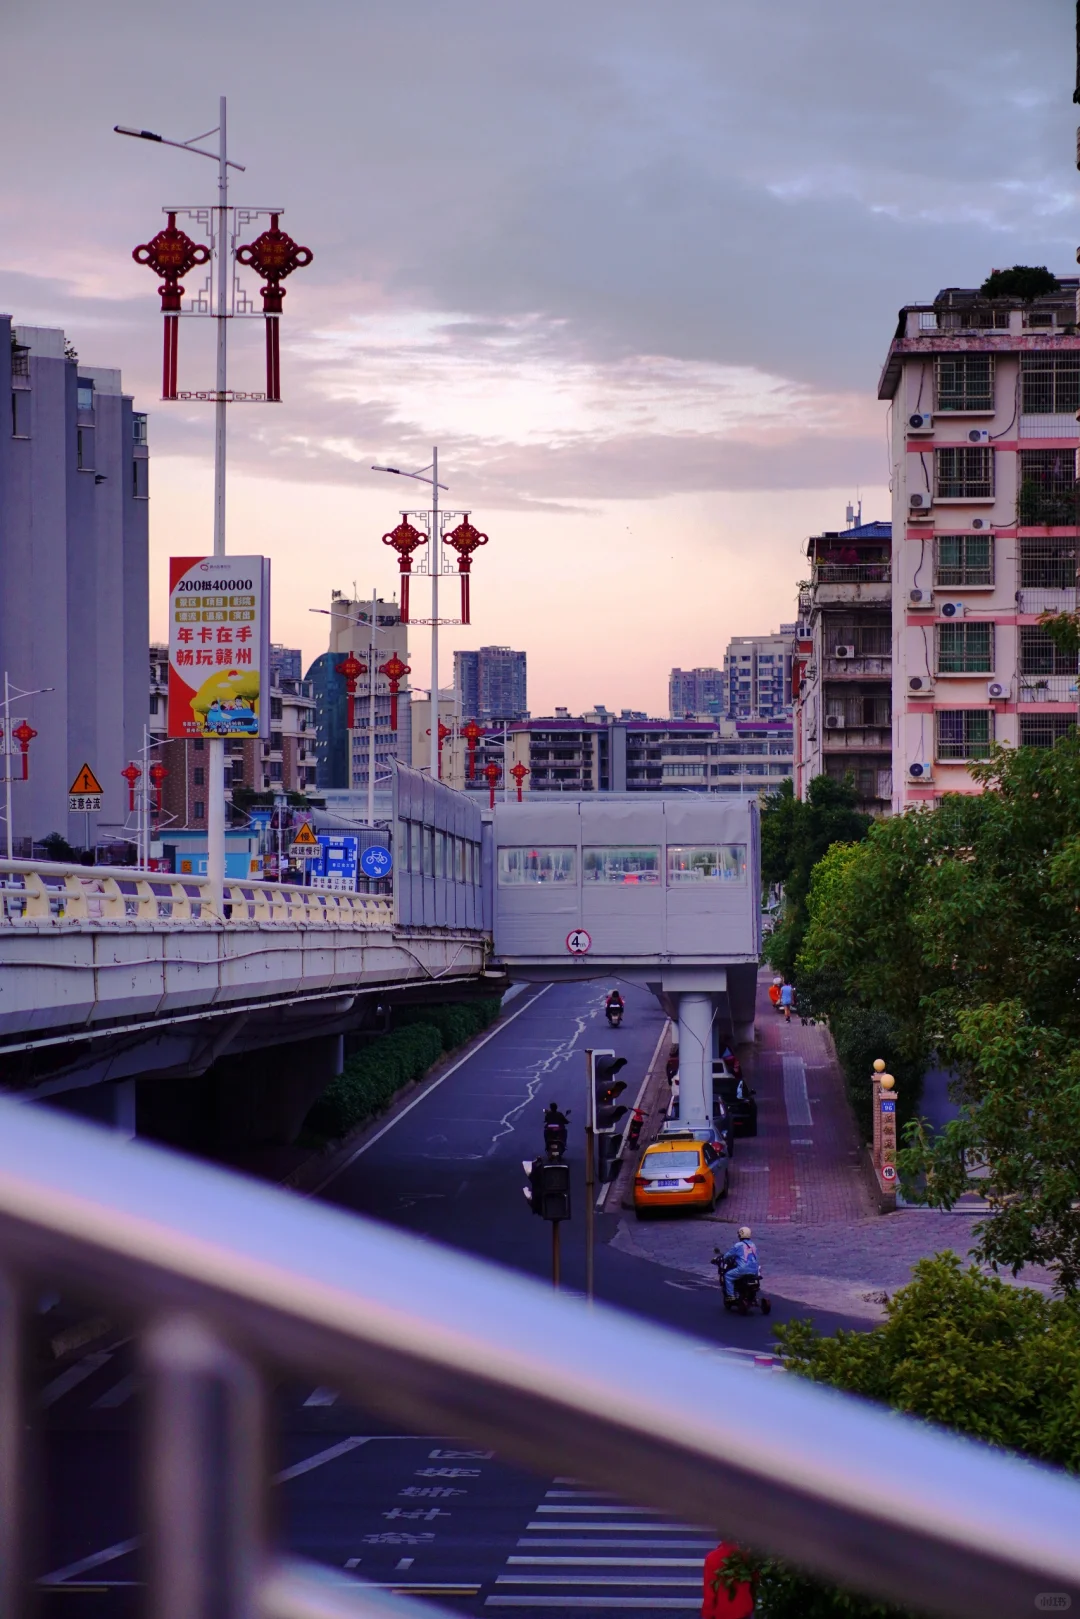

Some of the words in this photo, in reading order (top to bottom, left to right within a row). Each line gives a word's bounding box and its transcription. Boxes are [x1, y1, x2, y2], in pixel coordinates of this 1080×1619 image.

[178, 579, 253, 592] 200抵40000
[180, 598, 197, 607] 景区
[206, 597, 223, 606] 项目
[233, 596, 251, 606] 影院
[179, 612, 197, 621] 漂流
[206, 612, 224, 621] 温泉
[233, 611, 251, 620] 演出
[177, 625, 253, 644] 年卡在手
[176, 647, 252, 666] 畅玩赣州
[69, 798, 101, 810] 注意合流
[300, 832, 310, 841] 慢
[290, 847, 320, 856] 减速慢行
[884, 1168, 894, 1177] 慢
